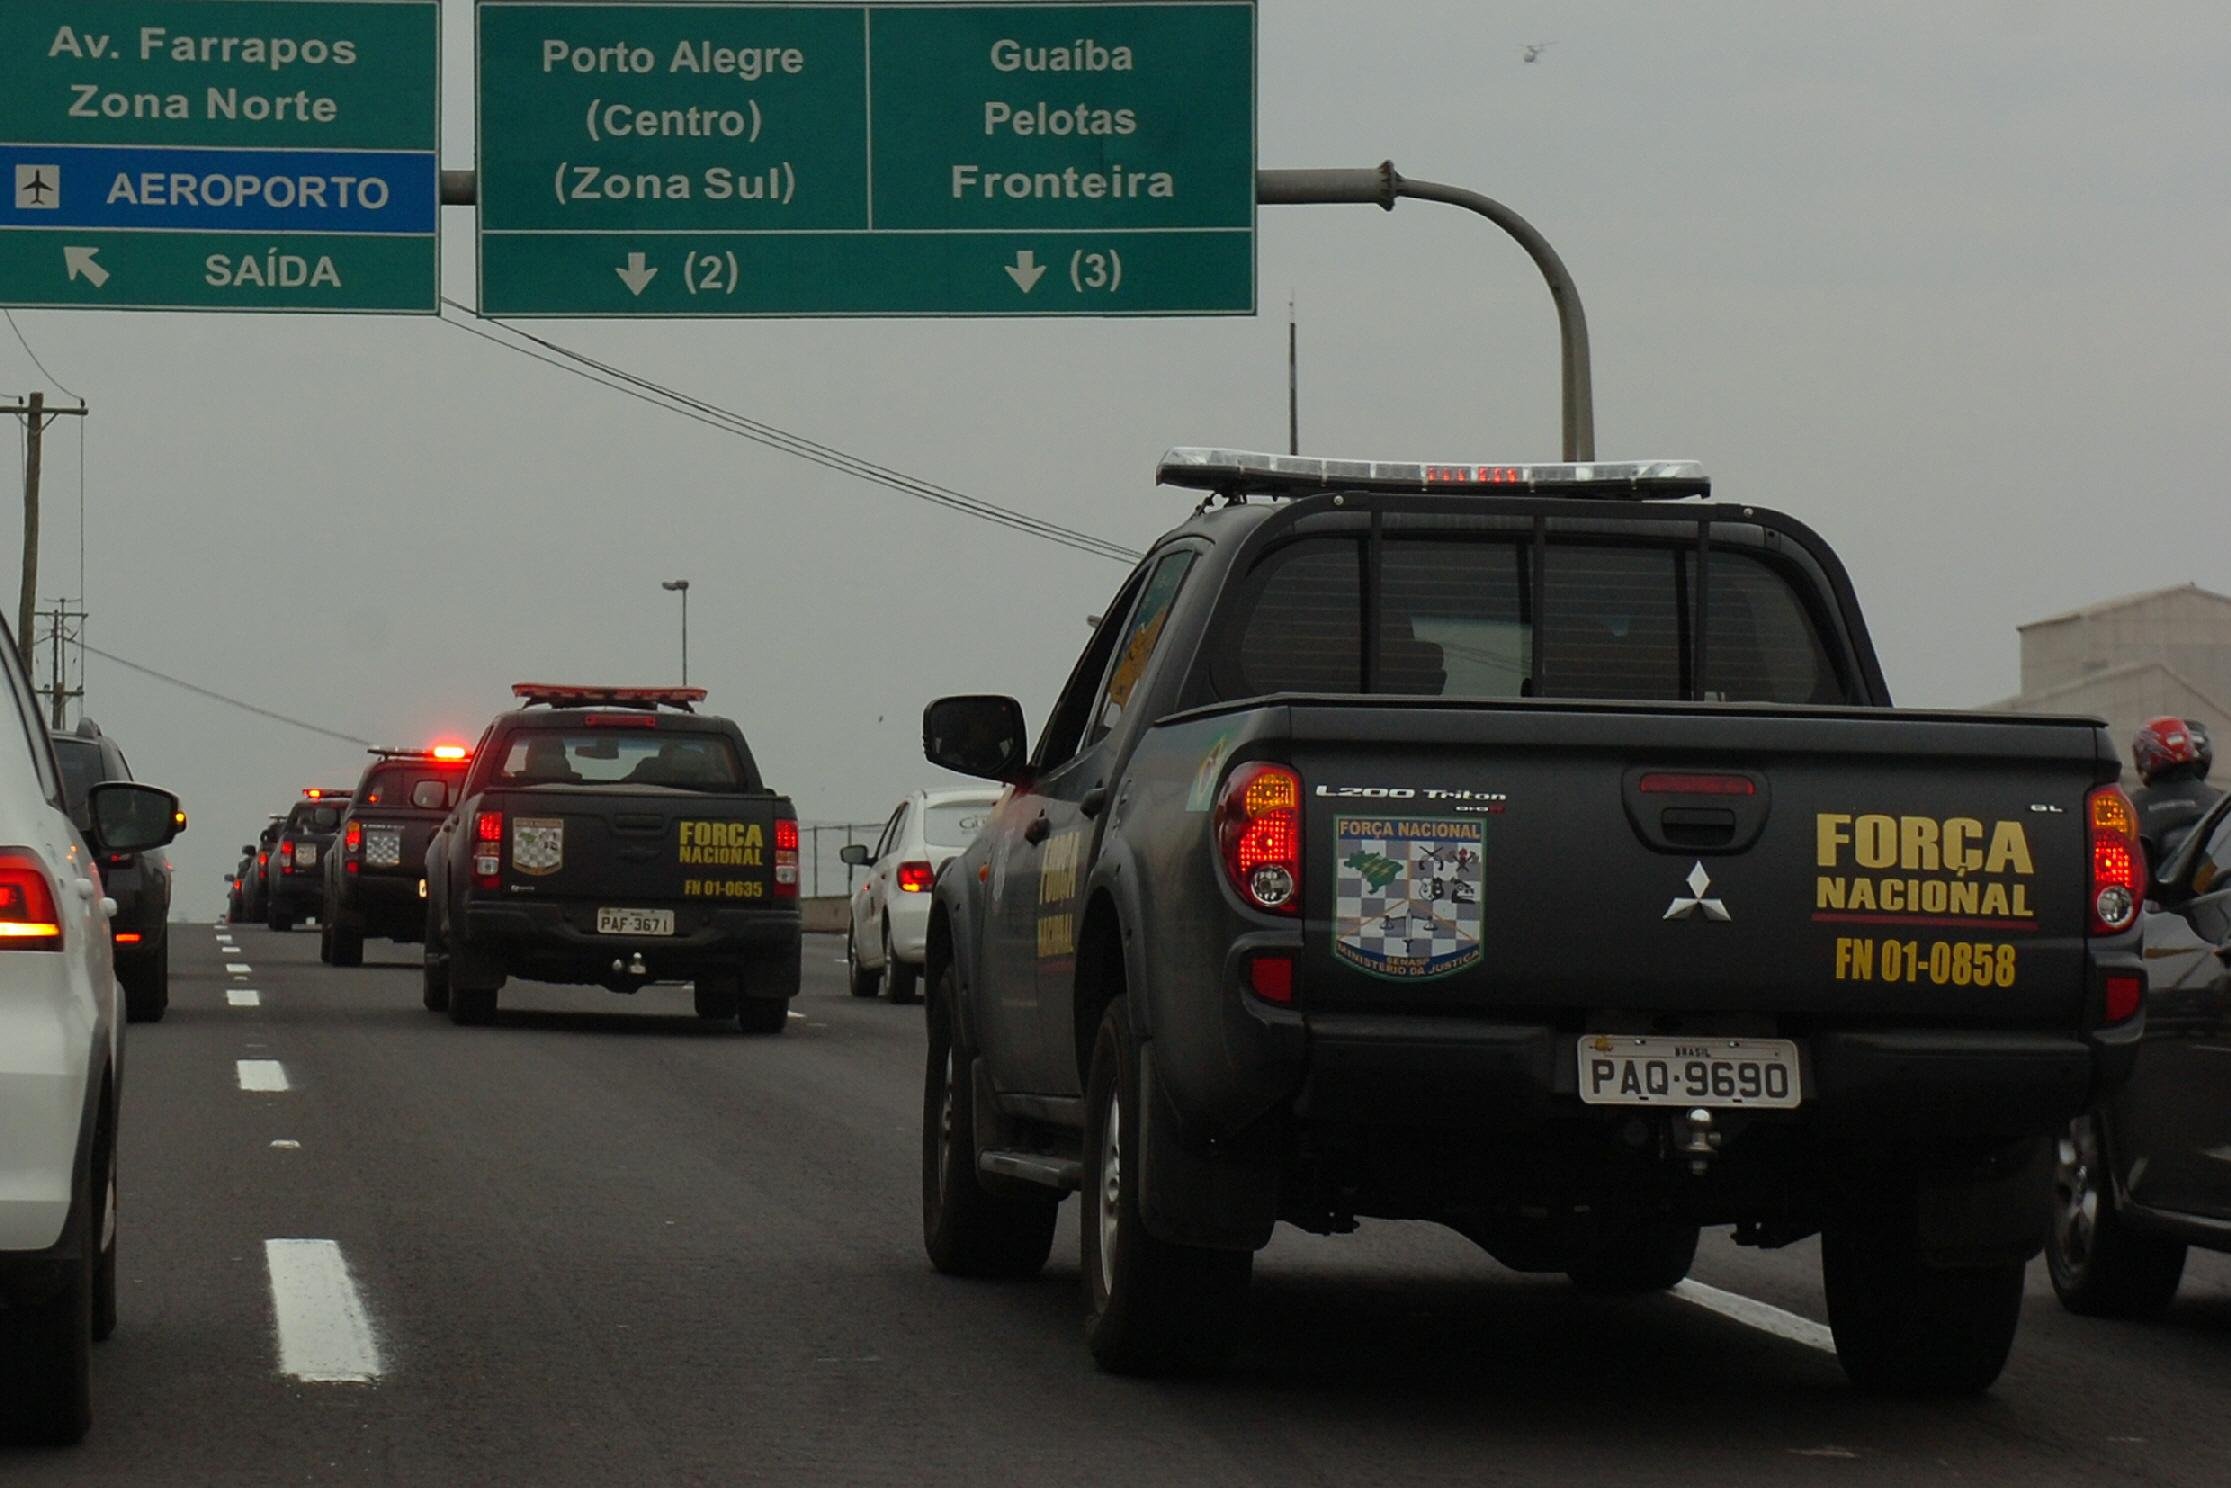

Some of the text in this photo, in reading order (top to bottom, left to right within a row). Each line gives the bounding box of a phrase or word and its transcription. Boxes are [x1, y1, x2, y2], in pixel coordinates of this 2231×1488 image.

[47, 25, 357, 71] Av. Farrapos
[543, 39, 805, 82] Porto Alegre
[990, 38, 1134, 72] Guaíba
[68, 84, 338, 123] Zona Norte
[586, 98, 763, 143] (Centro)
[984, 101, 1138, 136] Pelotas
[106, 172, 390, 210] AEROPORTO
[554, 161, 797, 206] (Zona Sul)
[951, 164, 1175, 200] Fronteira
[205, 247, 343, 289] SAÍDA
[684, 250, 739, 295] (2)
[1069, 249, 1122, 293] (3)
[1315, 784, 1508, 801] L200 Triton
[1339, 820, 1481, 842] FORÇA NACIONAL
[1816, 813, 2035, 878] FORÇA
[679, 845, 763, 867] NACIONAL
[684, 879, 702, 896] FN
[1816, 876, 2035, 917] NACIONAL
[1835, 937, 2017, 988] FN 01-0858
